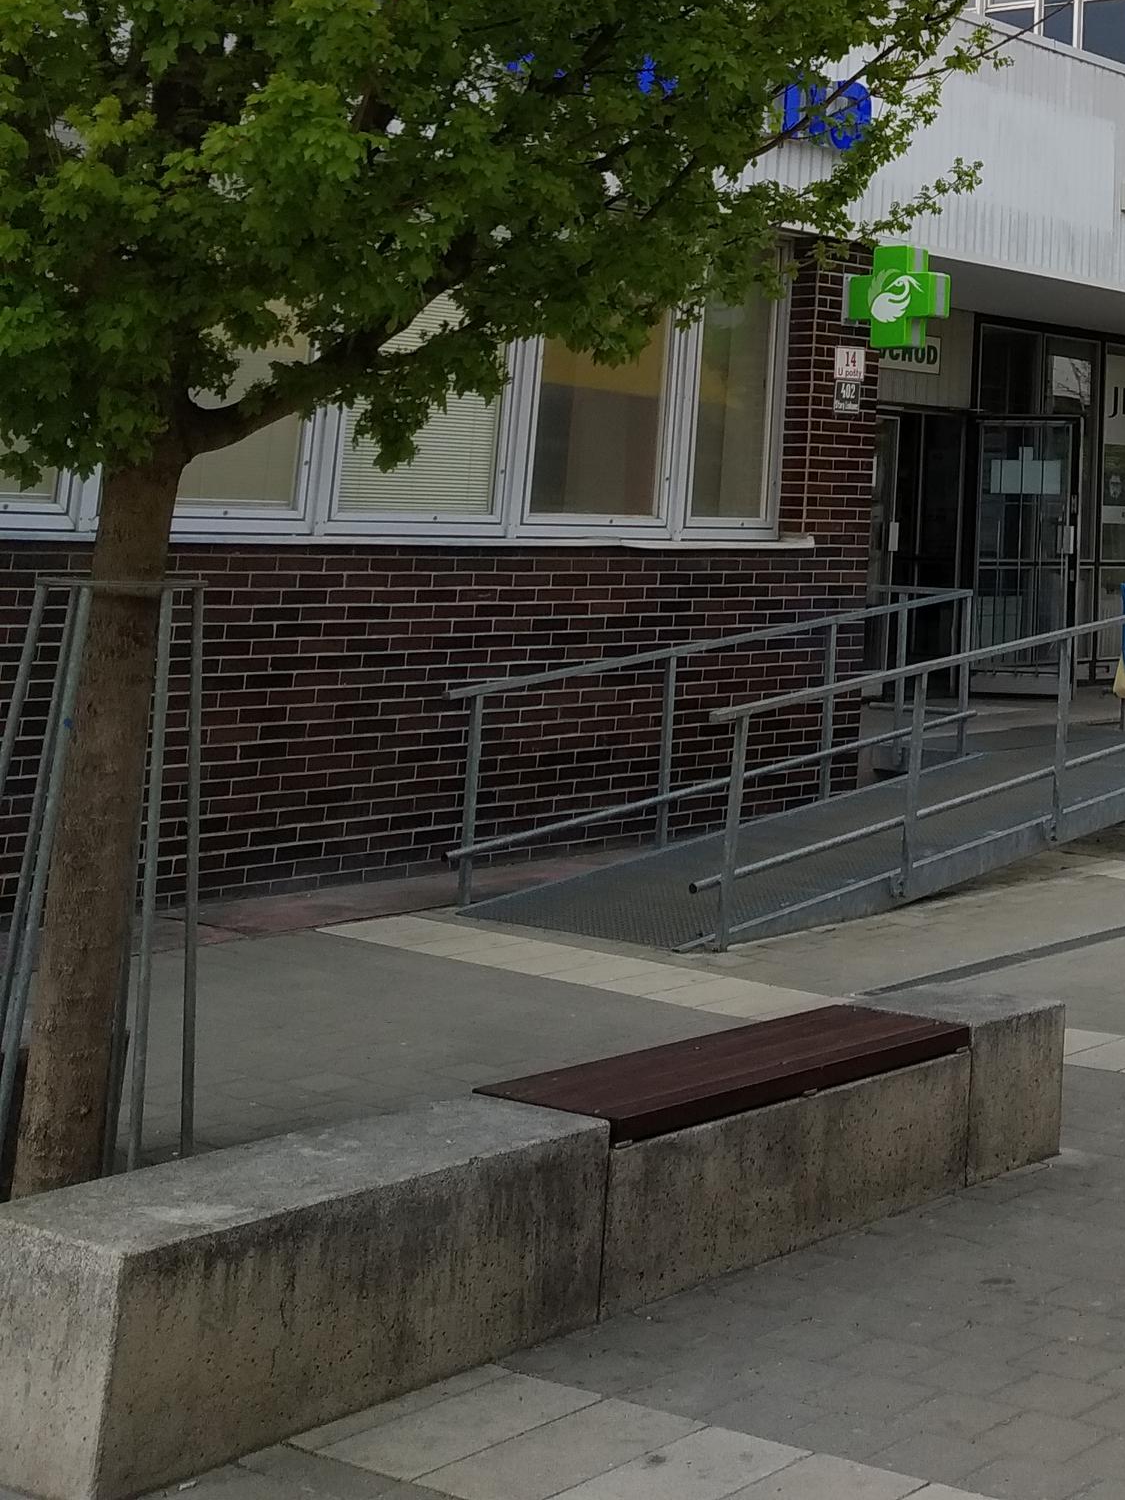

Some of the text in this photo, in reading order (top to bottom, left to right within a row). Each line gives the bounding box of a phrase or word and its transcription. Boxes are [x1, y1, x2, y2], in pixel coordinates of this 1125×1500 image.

[845, 351, 857, 367] 14
[837, 367, 844, 376] U
[841, 383, 856, 399] 402
